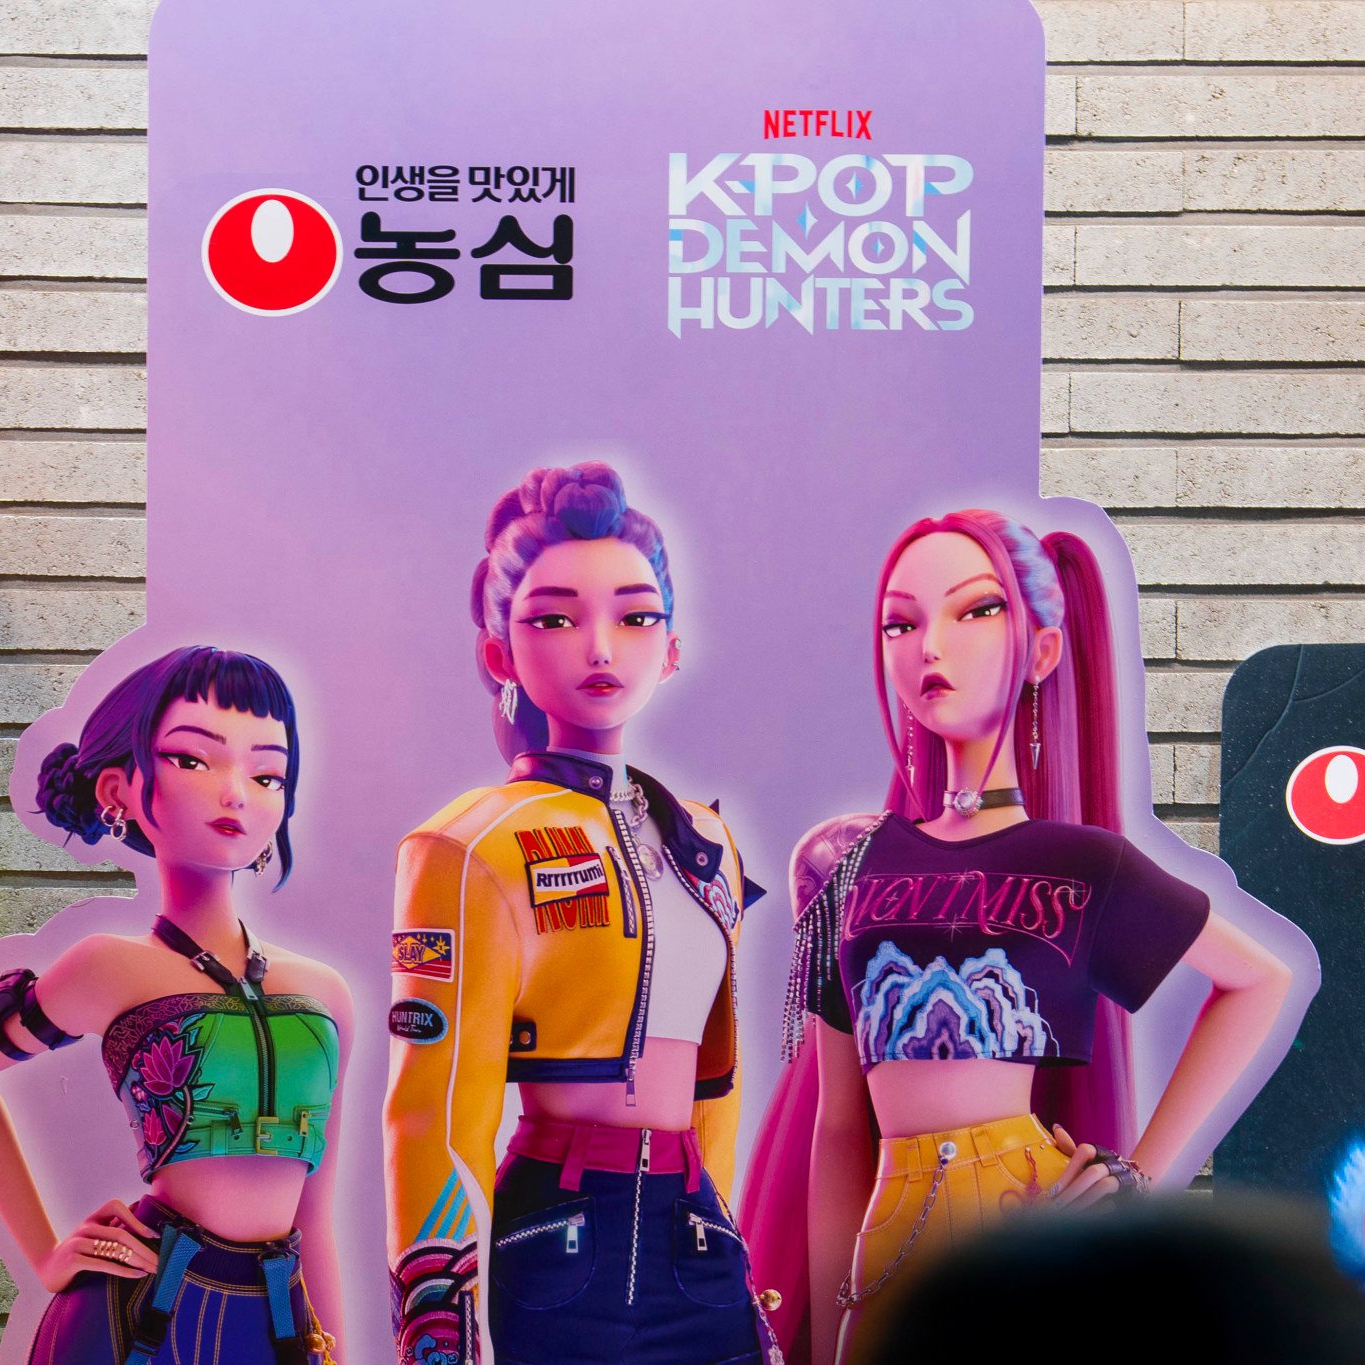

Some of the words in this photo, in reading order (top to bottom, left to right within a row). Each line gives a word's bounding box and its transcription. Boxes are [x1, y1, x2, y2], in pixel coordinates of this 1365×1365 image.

[764, 110, 874, 140] NETFLIX
[355, 165, 460, 203] 인생을
[468, 165, 577, 204] 맛있게
[669, 152, 975, 217] KPOP
[354, 211, 575, 305] 농심
[669, 210, 973, 288] DEMON
[669, 275, 975, 340] HUNTERS
[397, 942, 426, 964] SLAY
[391, 1010, 434, 1027] HUNTRIX
